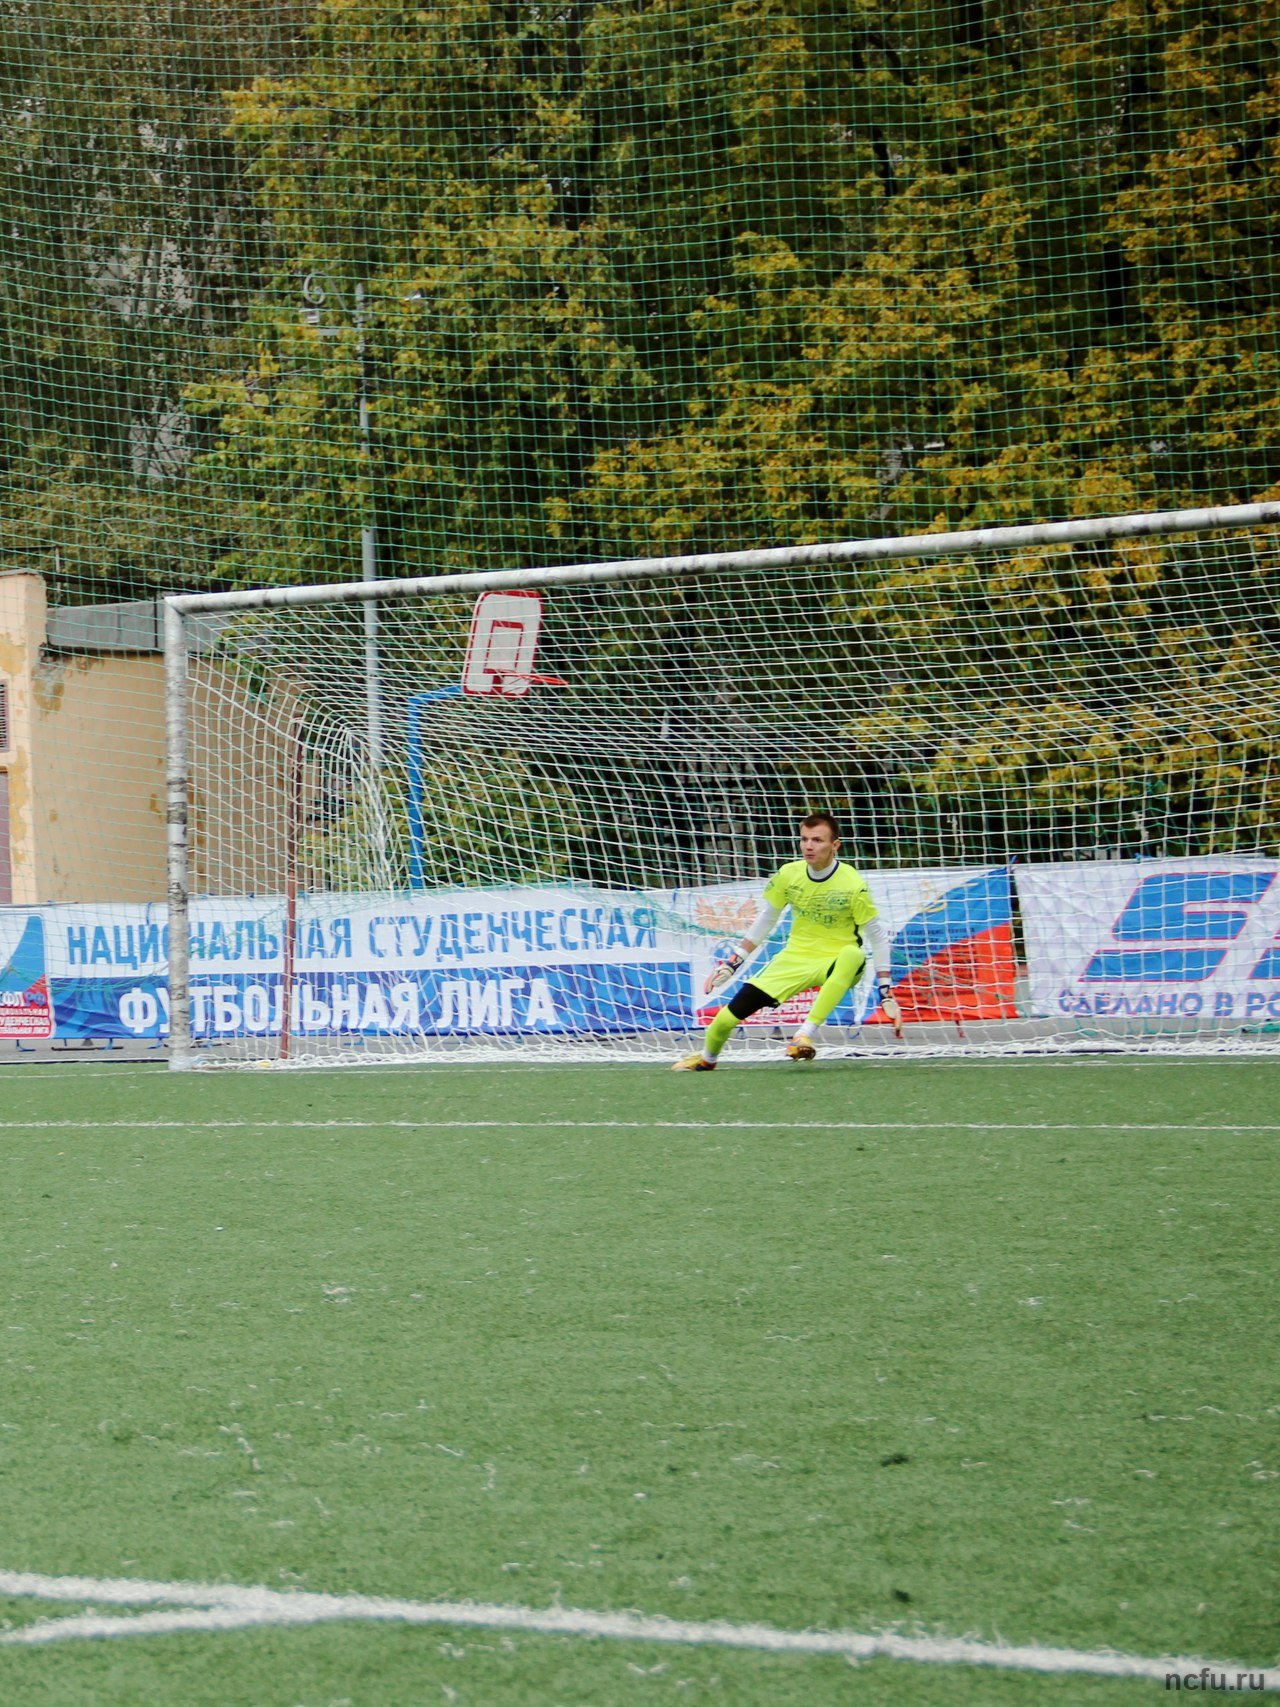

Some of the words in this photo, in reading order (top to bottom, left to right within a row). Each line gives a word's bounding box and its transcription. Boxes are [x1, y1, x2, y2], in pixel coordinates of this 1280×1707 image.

[369, 907, 657, 962] СТУДЕНЧЕСКАЯ
[435, 977, 558, 1029] ЛИГА
[1214, 991, 1234, 1017] В
